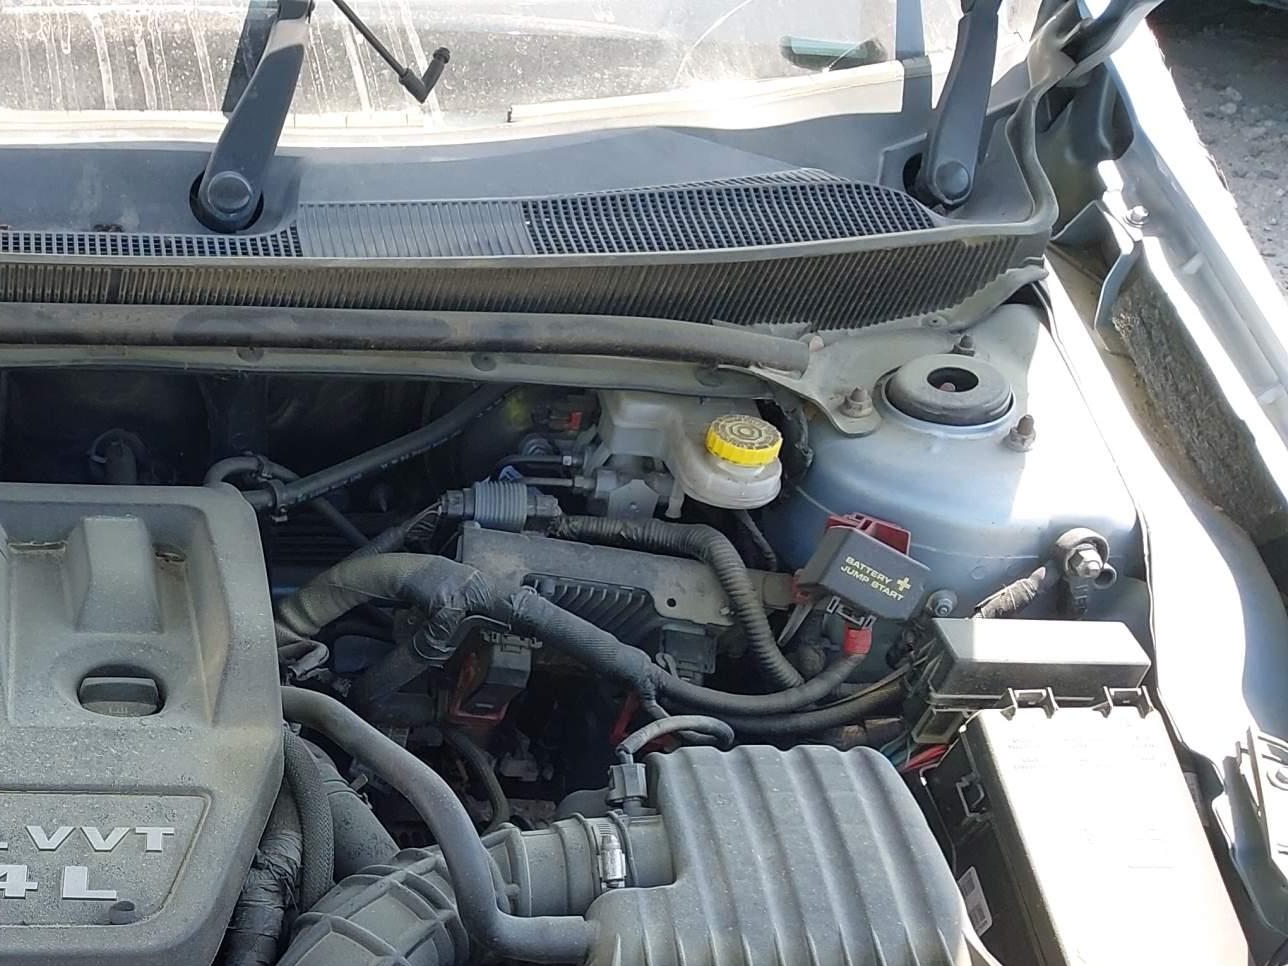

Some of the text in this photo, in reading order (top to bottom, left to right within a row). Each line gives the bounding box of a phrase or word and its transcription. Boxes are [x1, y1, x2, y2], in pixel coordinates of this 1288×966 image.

[840, 565, 904, 601] JUMP START
[845, 556, 893, 585] BATTERY
[25, 825, 175, 852] VVT
